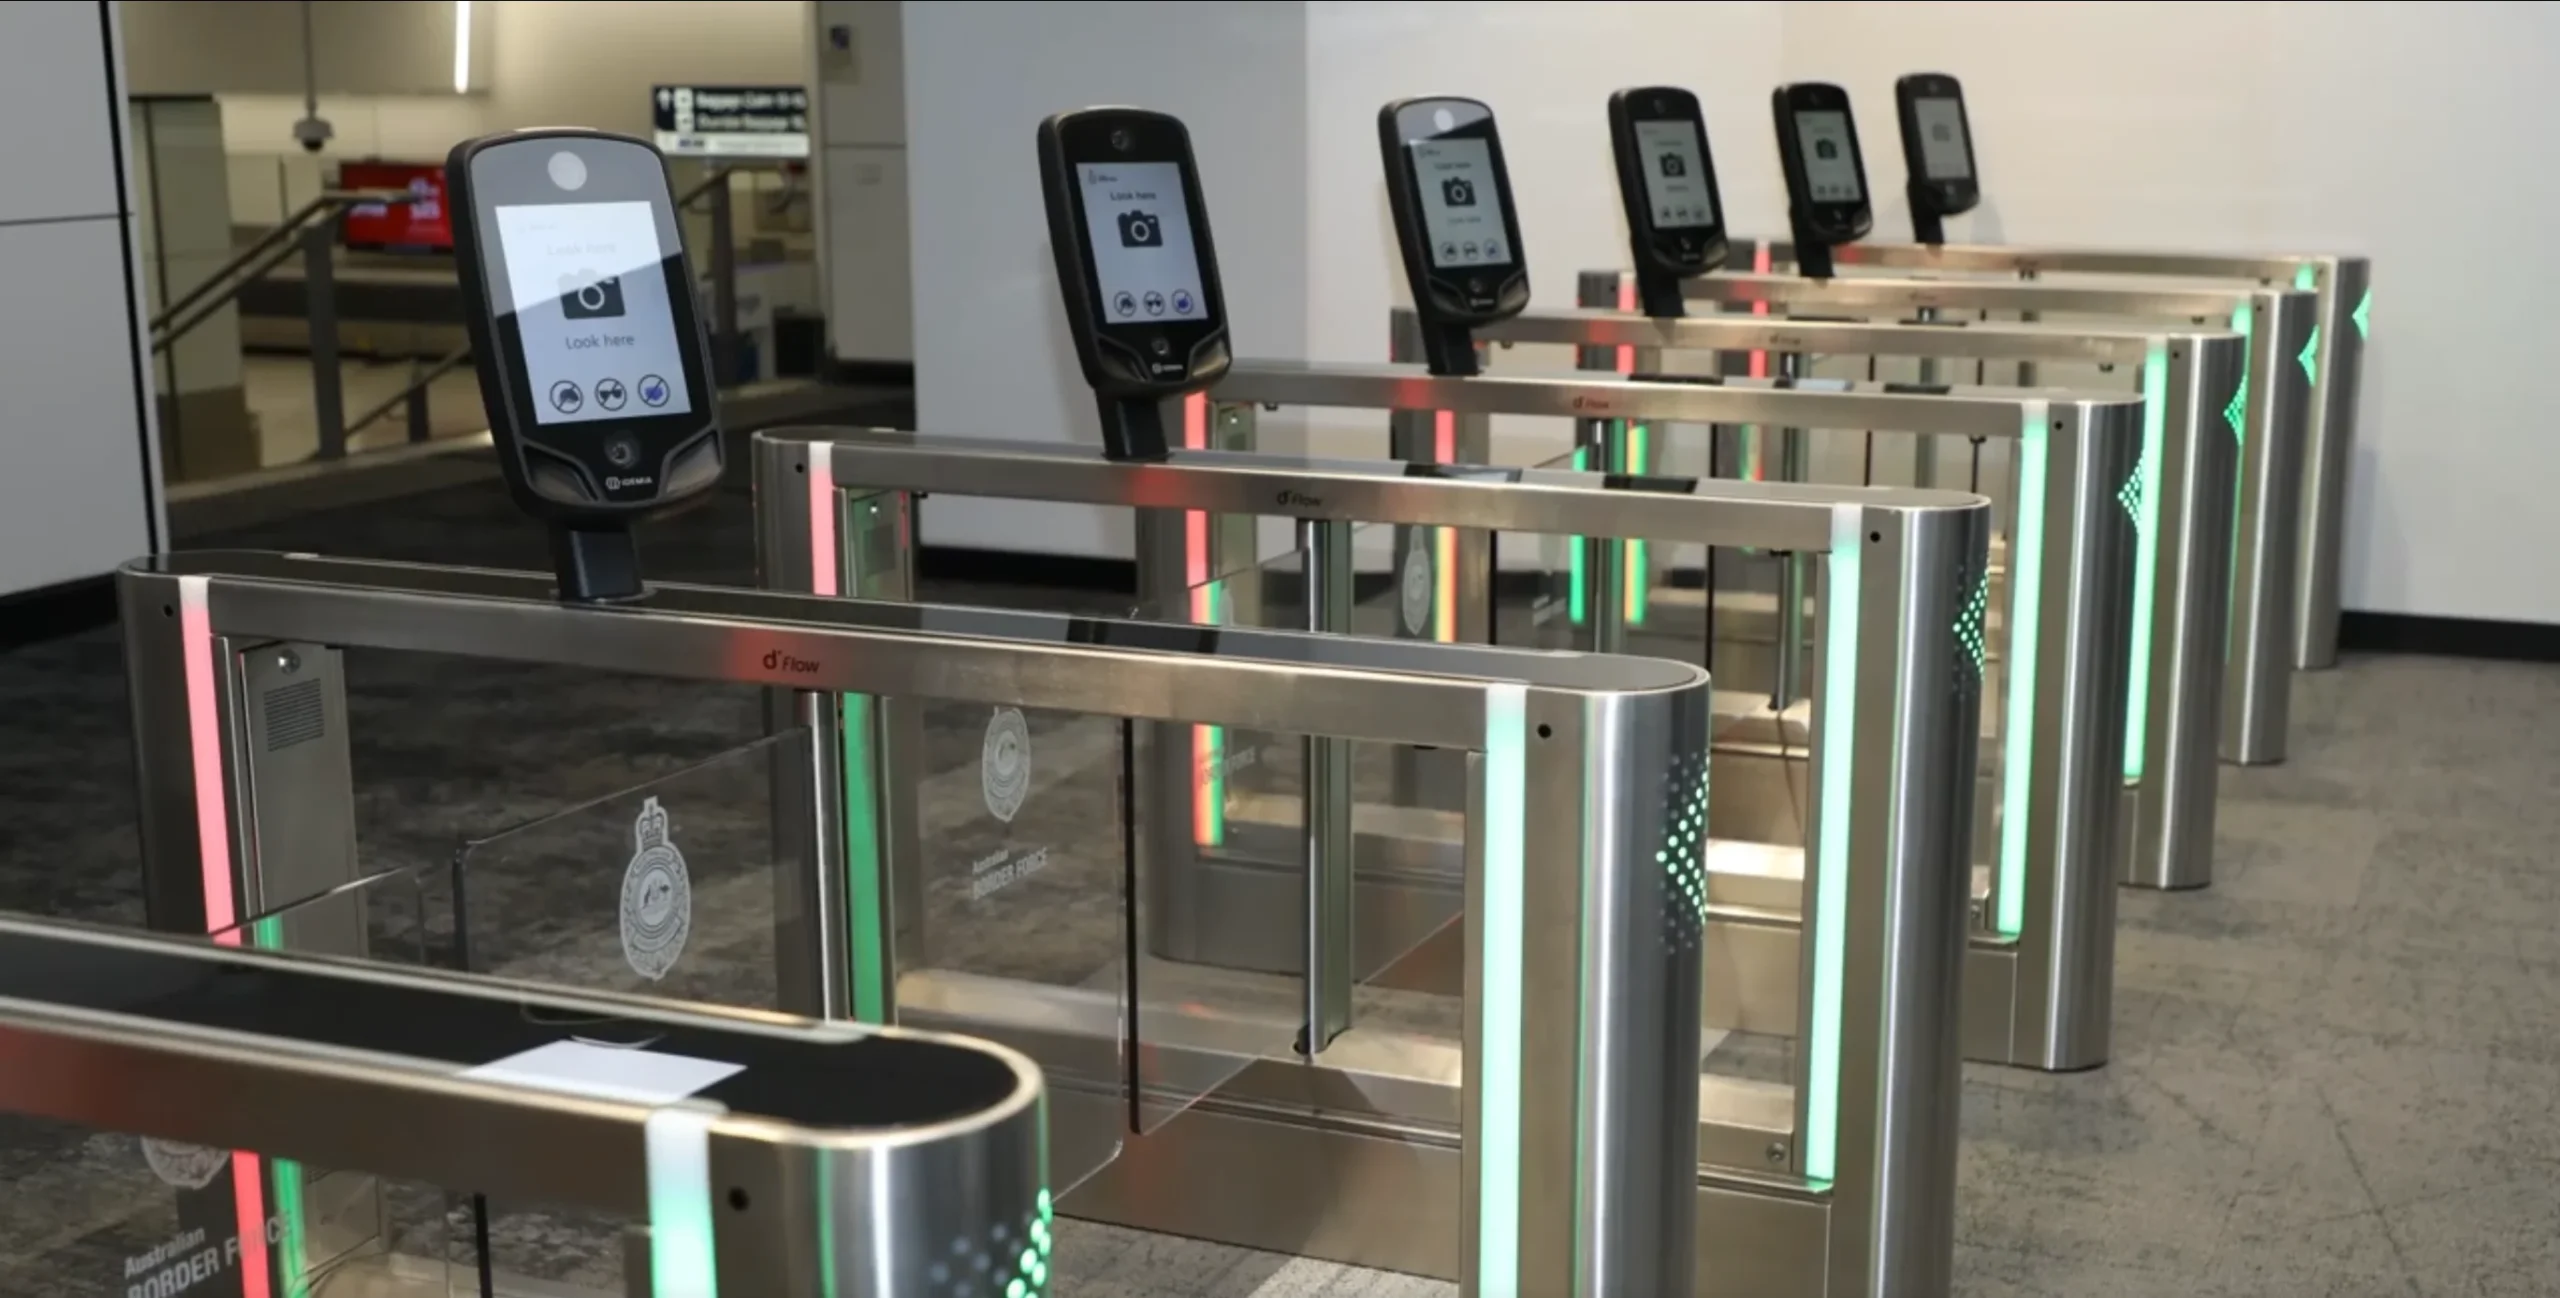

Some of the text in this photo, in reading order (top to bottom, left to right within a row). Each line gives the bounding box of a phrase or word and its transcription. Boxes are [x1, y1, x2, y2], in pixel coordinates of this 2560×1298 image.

[565, 332, 635, 350] Look here
[124, 1227, 206, 1280] Australian
